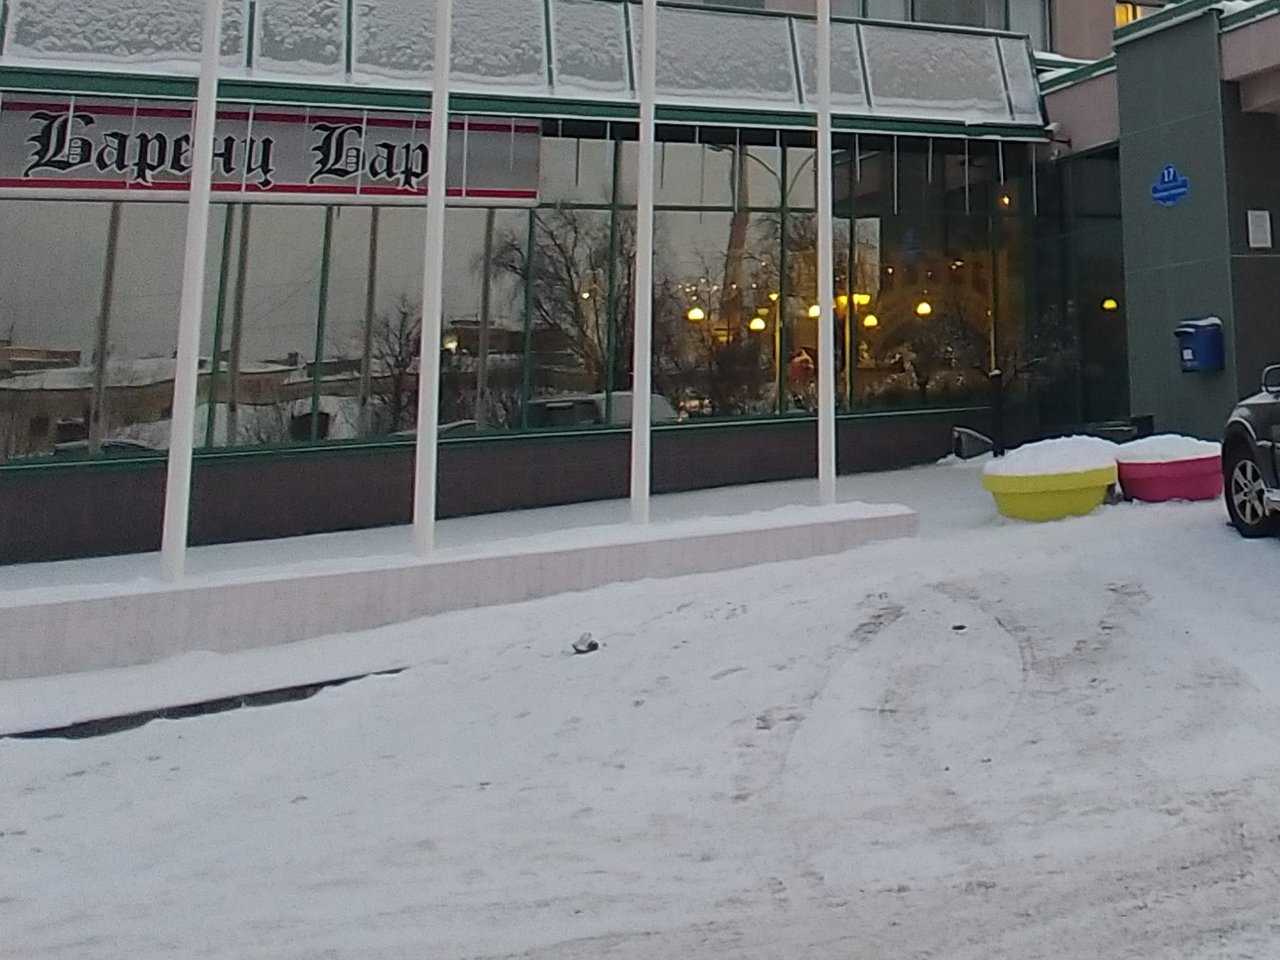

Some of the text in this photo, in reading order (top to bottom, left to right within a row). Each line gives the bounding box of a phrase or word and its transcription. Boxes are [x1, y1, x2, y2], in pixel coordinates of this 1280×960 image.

[22, 109, 429, 190] Баренц Бар
[1163, 168, 1175, 182] 17
